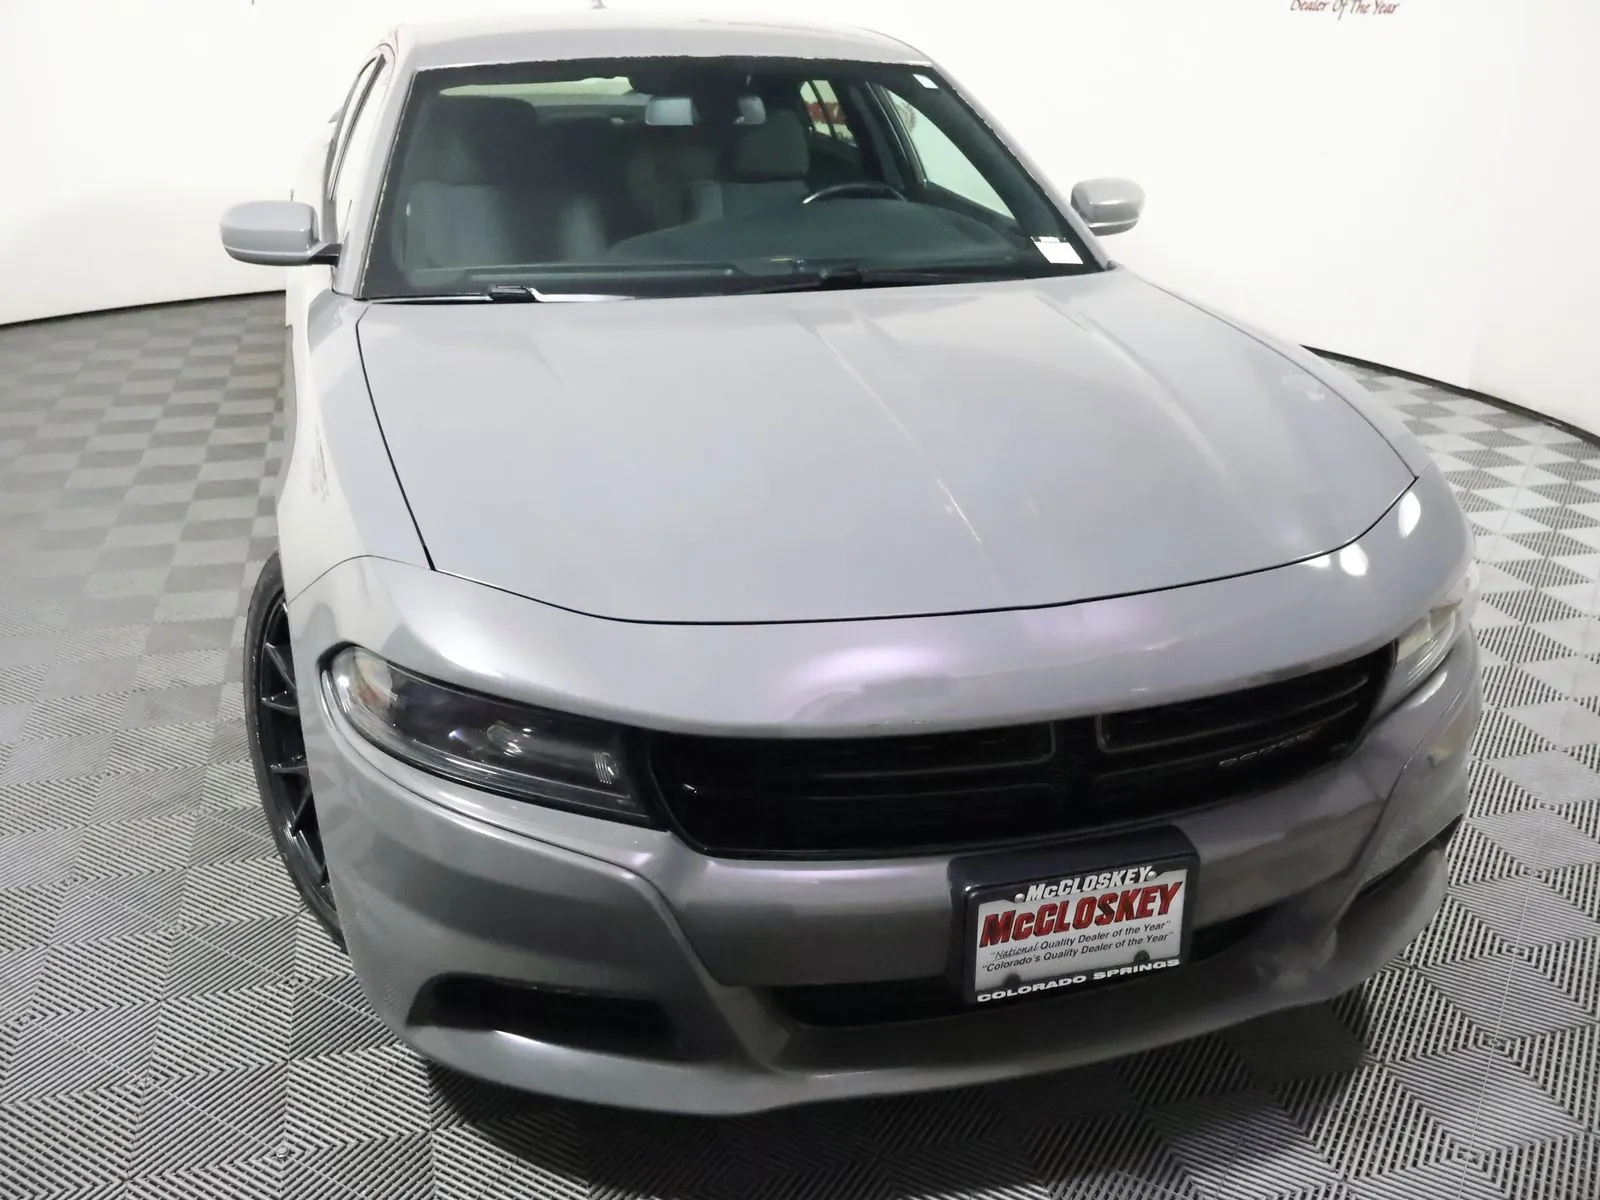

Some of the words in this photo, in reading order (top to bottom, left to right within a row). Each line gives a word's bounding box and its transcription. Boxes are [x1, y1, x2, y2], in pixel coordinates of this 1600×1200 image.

[1025, 866, 1154, 902] McCLOSKEY
[979, 881, 1183, 948] McCLOSKEY
[1040, 936, 1076, 950] Quality
[1078, 931, 1110, 944] Dealer
[1112, 928, 1123, 938] of
[1125, 926, 1141, 935] the
[1043, 947, 1079, 961] Quality
[1081, 942, 1112, 955] Dealer
[1115, 939, 1126, 949] of
[1127, 937, 1143, 946] the
[976, 974, 1087, 1003] COLORADO
[1092, 958, 1181, 980] SPRINGS
